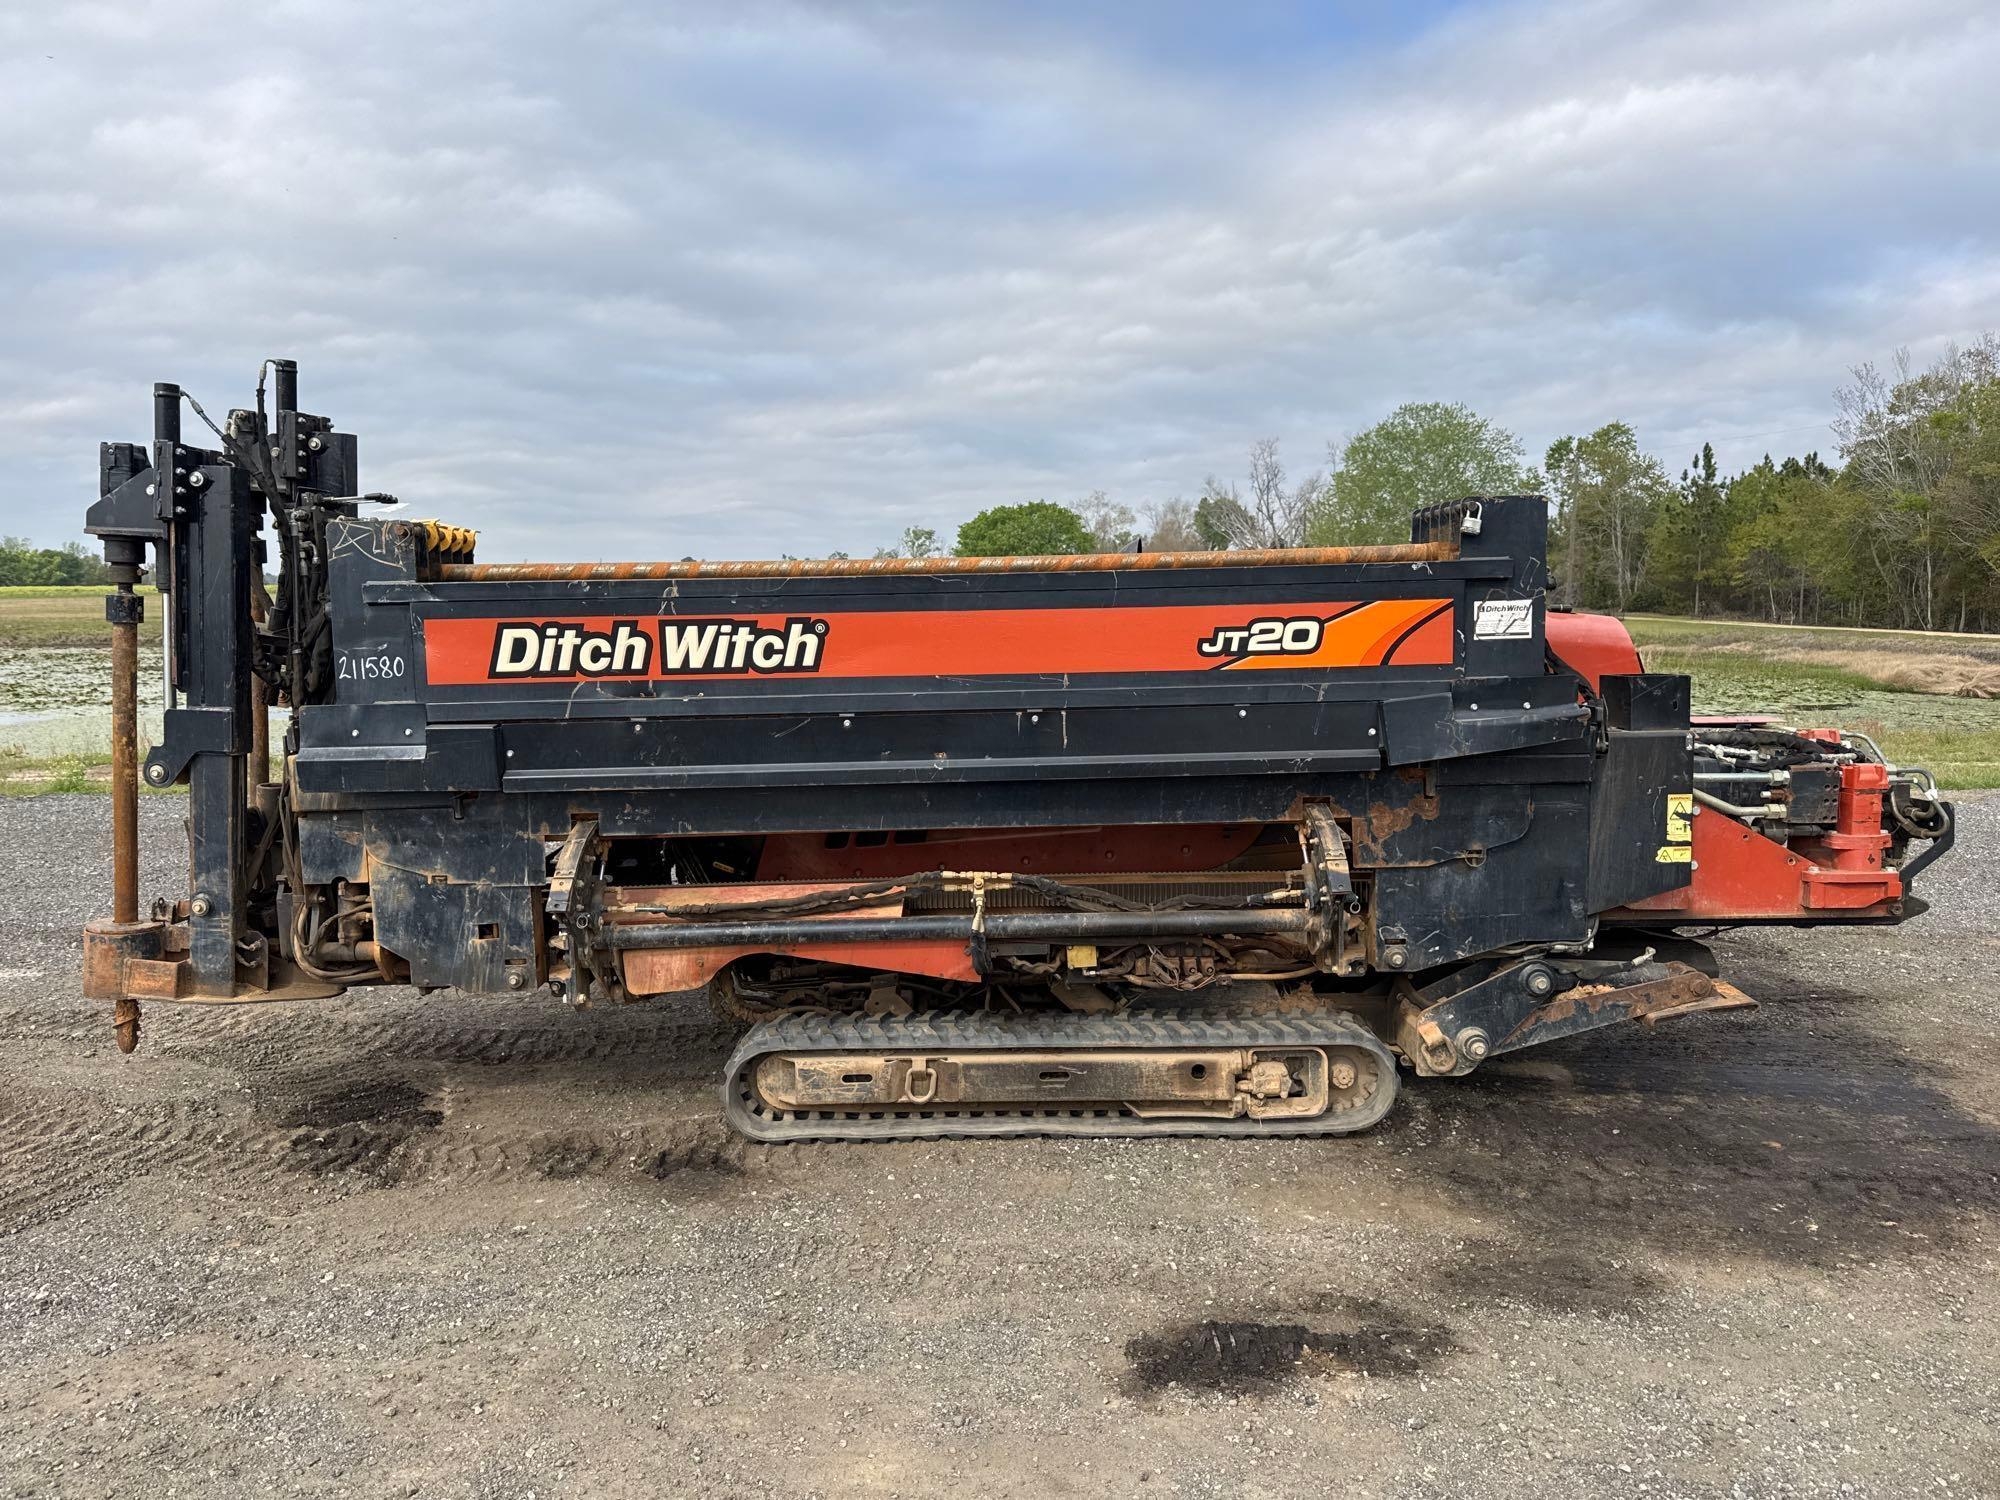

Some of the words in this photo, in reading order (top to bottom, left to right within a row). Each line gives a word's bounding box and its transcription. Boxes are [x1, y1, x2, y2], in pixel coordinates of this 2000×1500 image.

[495, 626, 647, 673] Ditch
[1201, 620, 1320, 653] JT20
[338, 655, 405, 680] 211580
